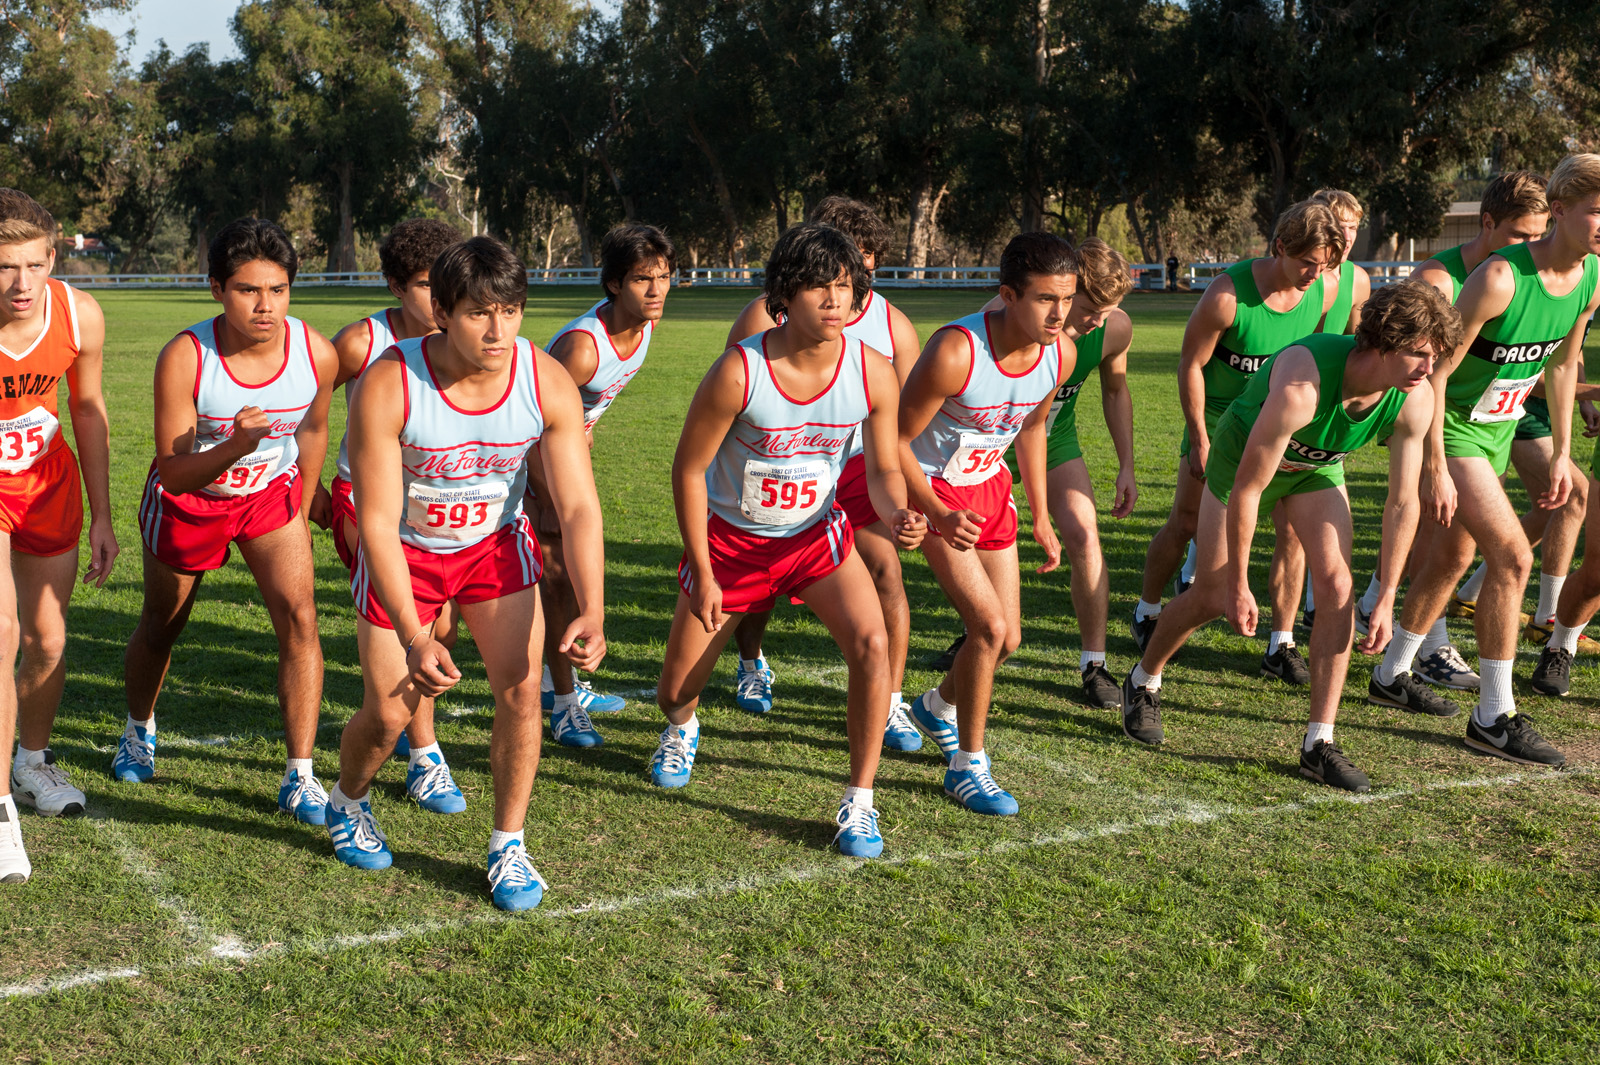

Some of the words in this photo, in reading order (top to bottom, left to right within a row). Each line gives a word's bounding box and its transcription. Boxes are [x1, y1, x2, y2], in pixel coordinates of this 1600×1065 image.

[1229, 354, 1269, 372] PAL
[1491, 344, 1542, 363] PALO
[1057, 380, 1084, 398] LTO
[0, 425, 45, 461] 35
[751, 429, 853, 454] McFarland
[1289, 440, 1328, 460] ALO
[767, 472, 791, 481] COUNTRY
[791, 469, 825, 480] CHAMPIONSHIP
[793, 466, 808, 474] STATE
[414, 494, 434, 502] CROSS
[461, 491, 503, 502] CHAMPIONSHIP
[760, 478, 818, 510] 595
[426, 502, 489, 529] 593
